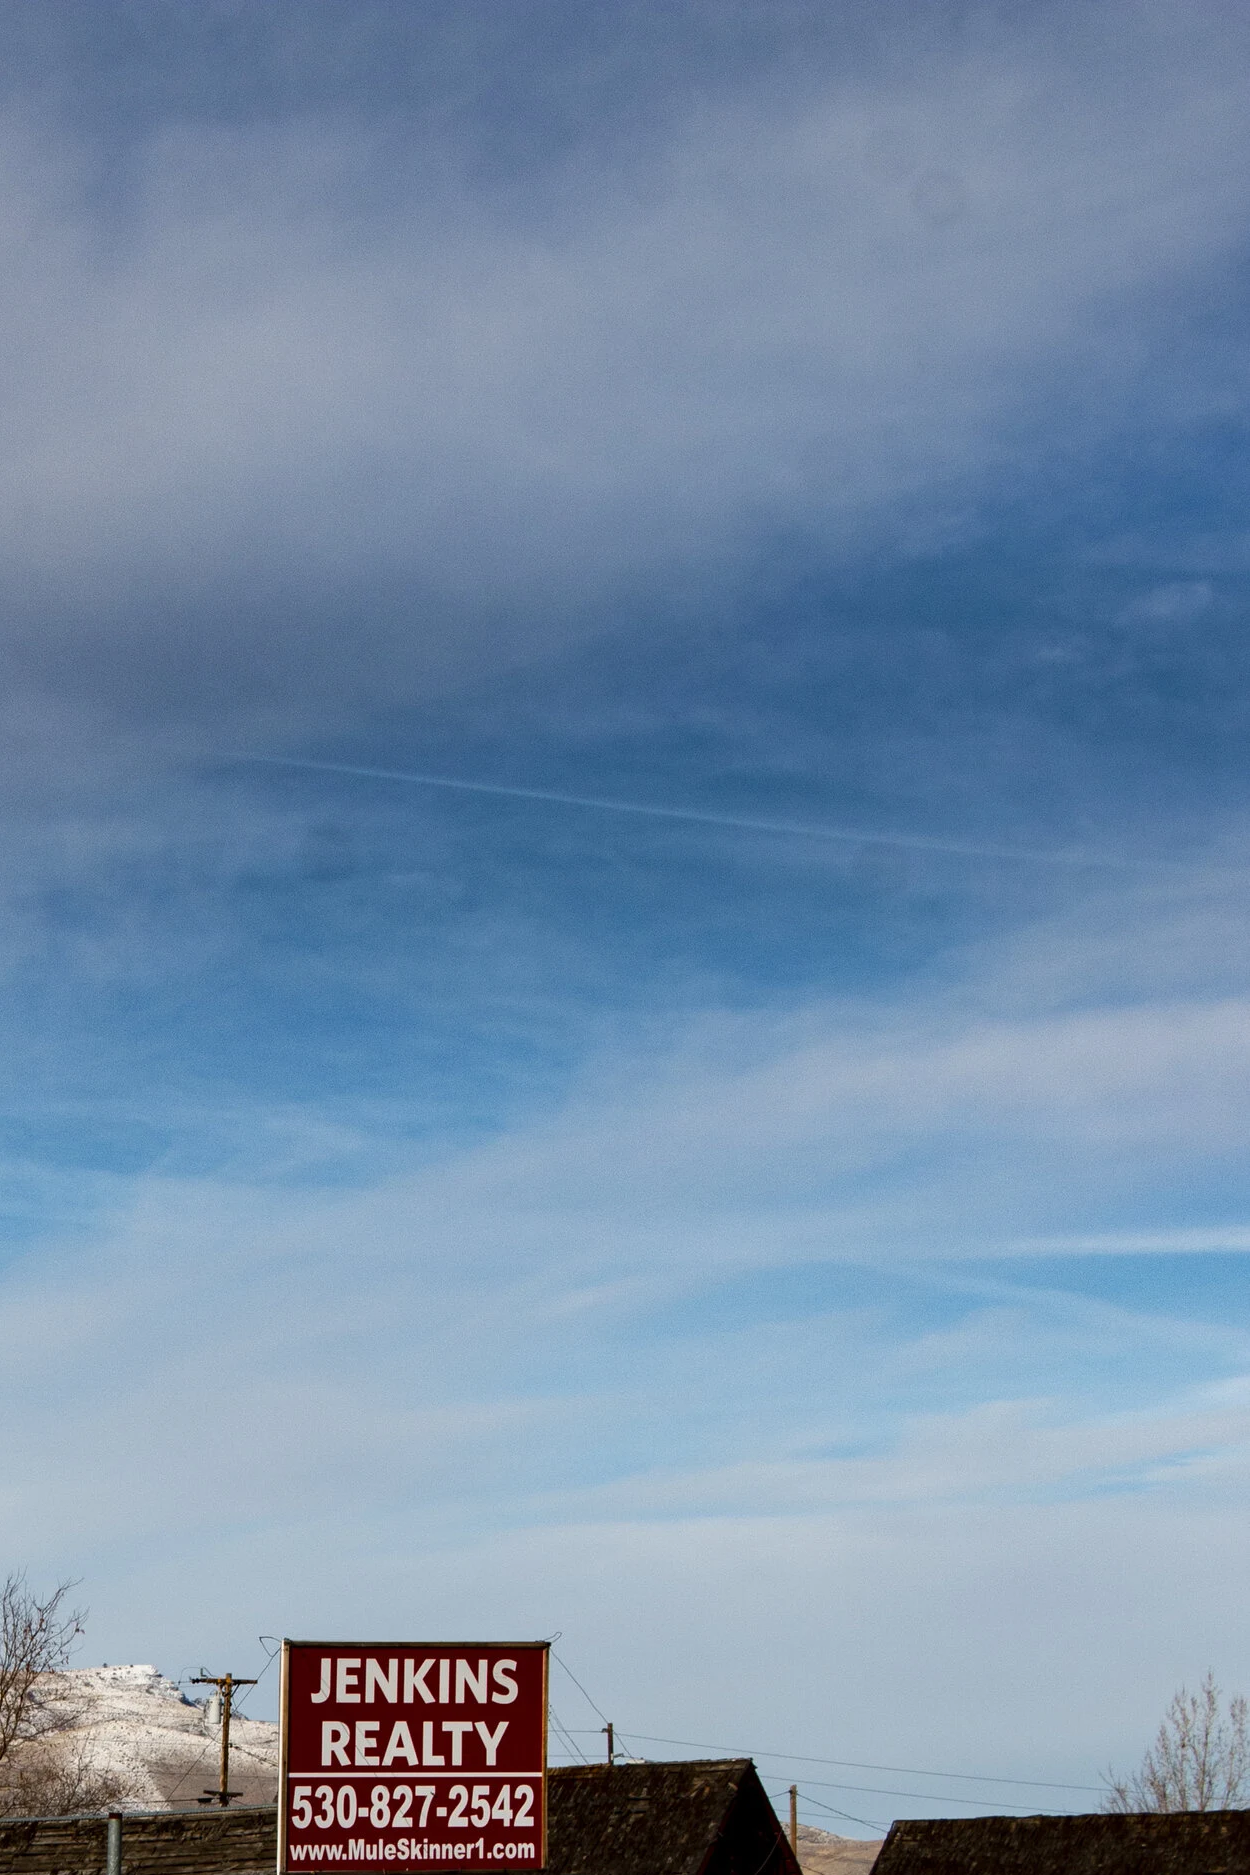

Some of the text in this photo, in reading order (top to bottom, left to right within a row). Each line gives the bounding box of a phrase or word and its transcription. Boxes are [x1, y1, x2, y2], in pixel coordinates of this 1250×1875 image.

[311, 1658, 519, 1705] JENKINS
[321, 1721, 510, 1767] REALTY
[291, 1784, 535, 1829] 530-827-2542
[290, 1838, 535, 1861] www.MuleSkinner1.com
